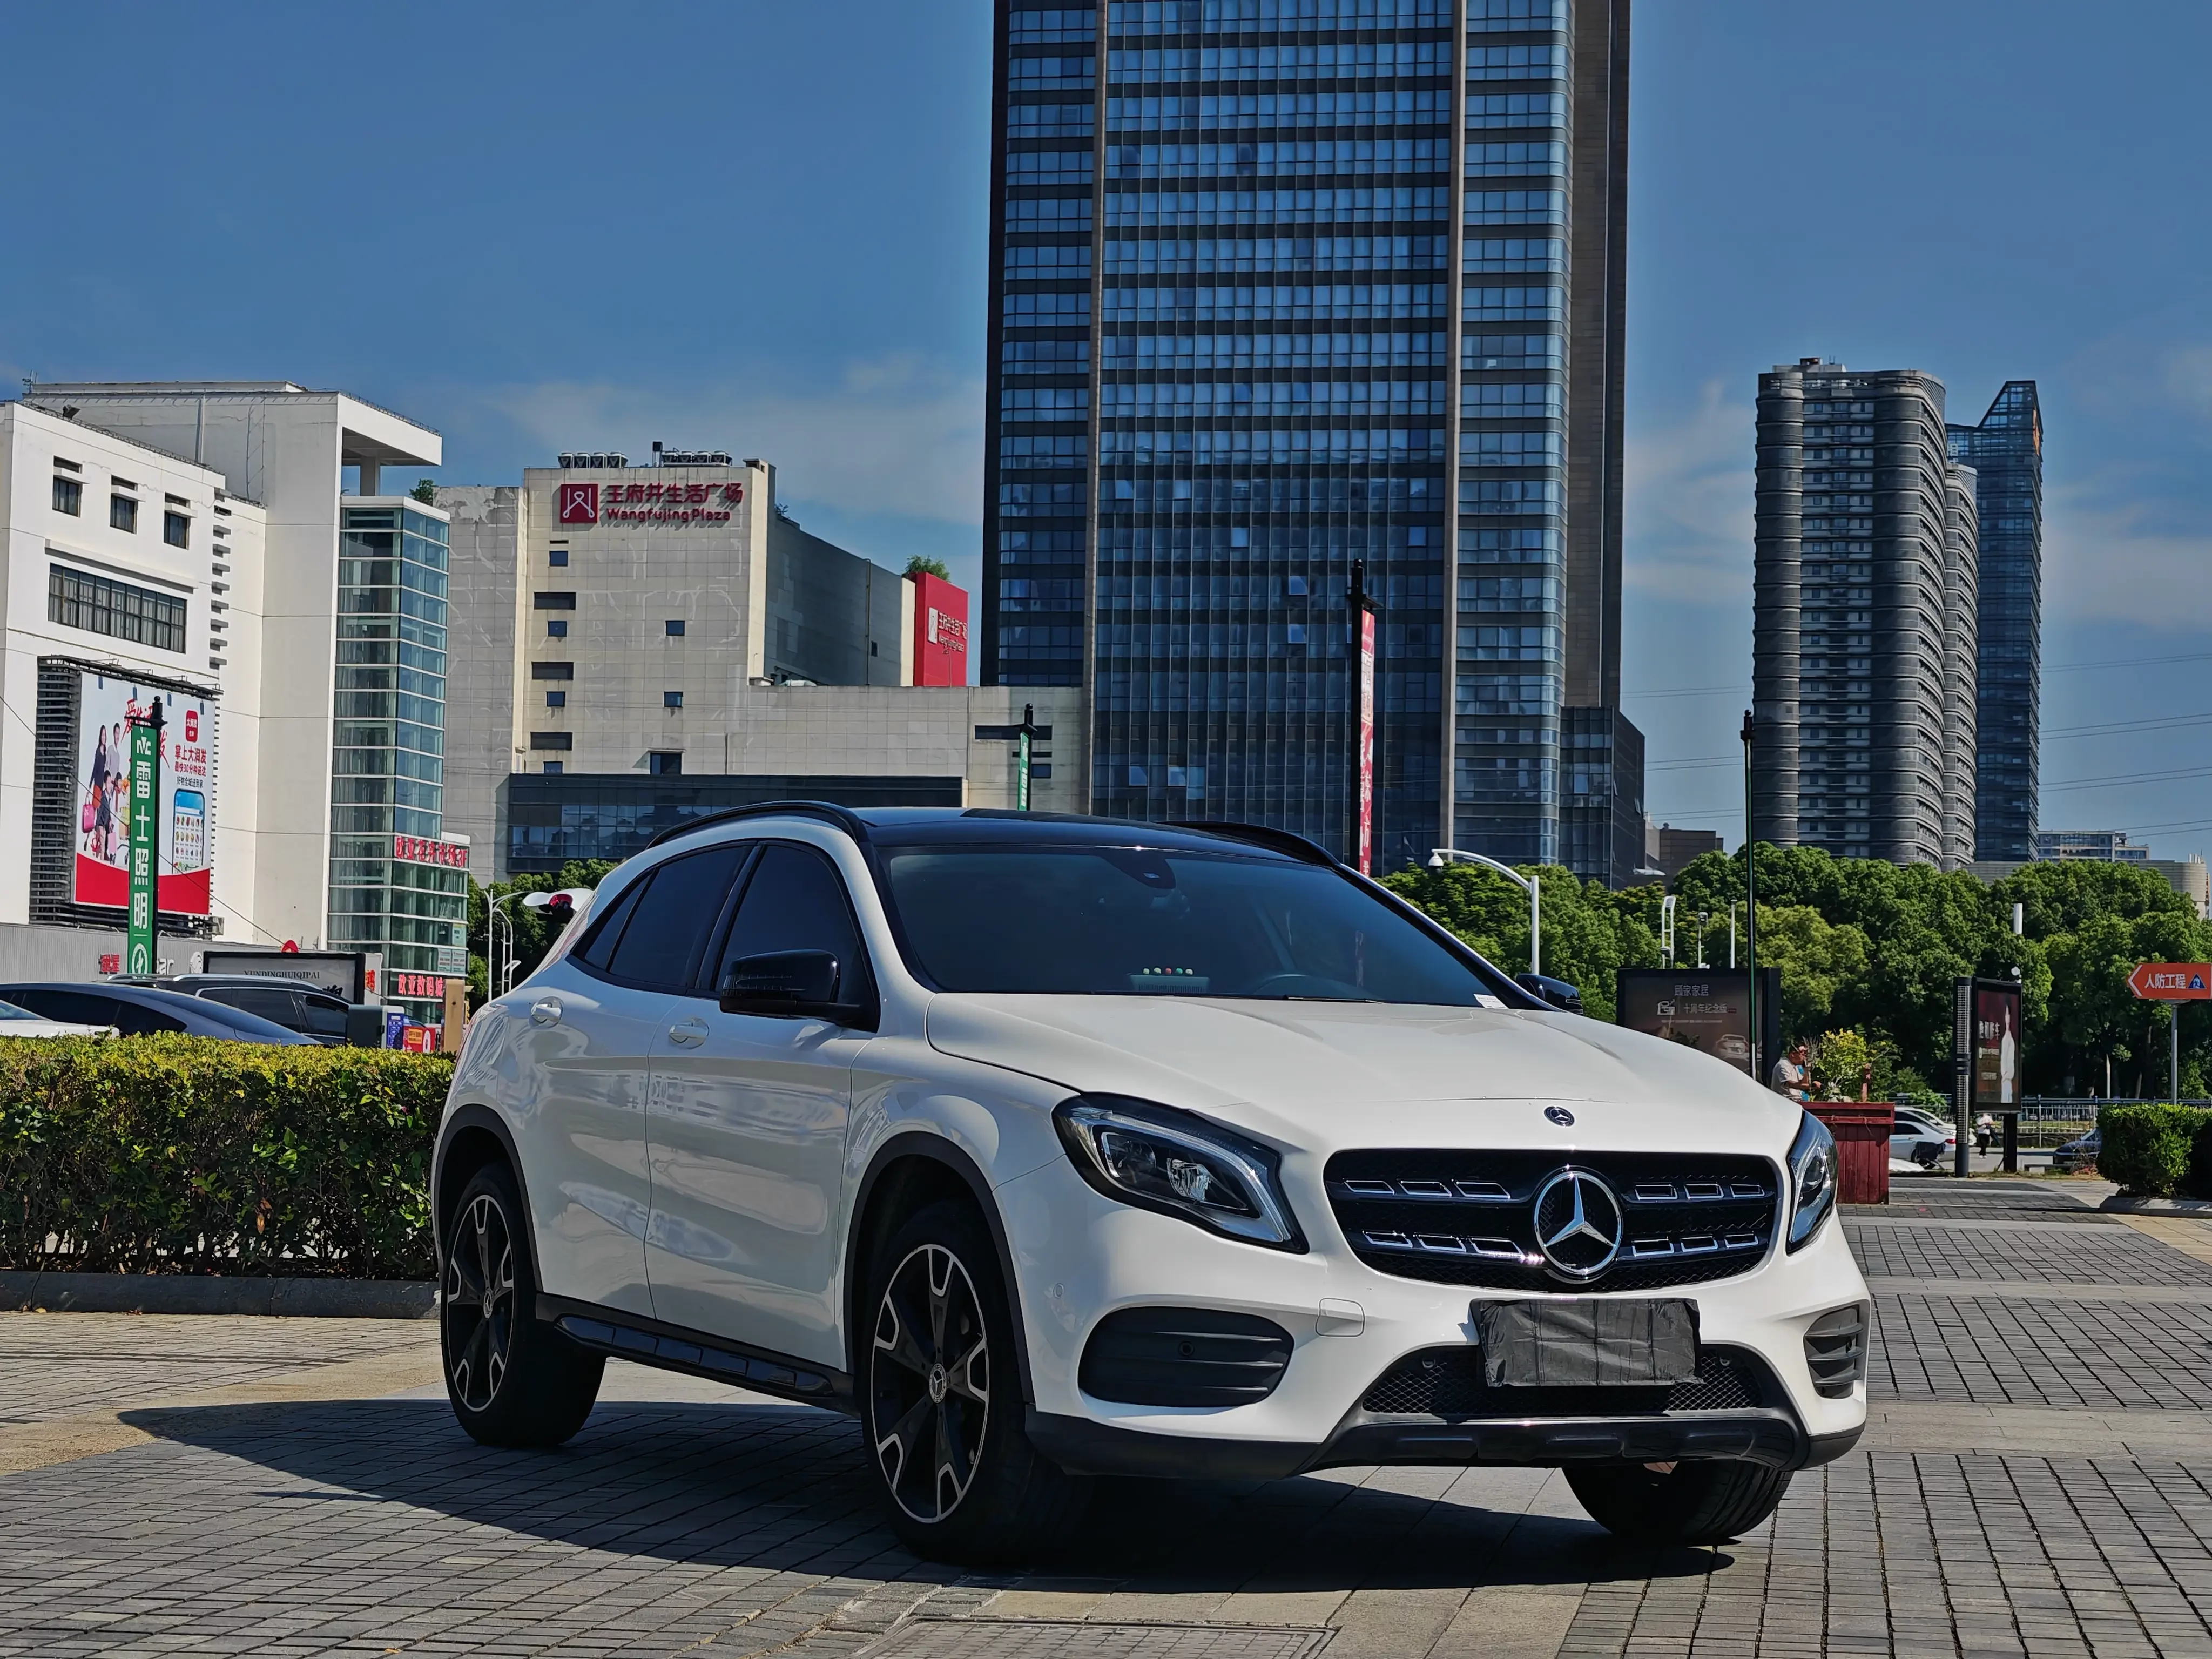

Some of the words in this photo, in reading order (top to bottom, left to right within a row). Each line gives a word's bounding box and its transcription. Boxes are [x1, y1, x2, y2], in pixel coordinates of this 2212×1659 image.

[606, 483, 744, 503] 王府井生活广场
[606, 508, 689, 522] Wangfujing
[693, 508, 731, 521] Plaza
[175, 744, 207, 764] 掌上大润发
[133, 760, 151, 929] 雷士照明
[398, 974, 443, 997] 欧亚数码城
[1674, 984, 1709, 996] 顾家家居
[2144, 973, 2186, 989] 人防工程
